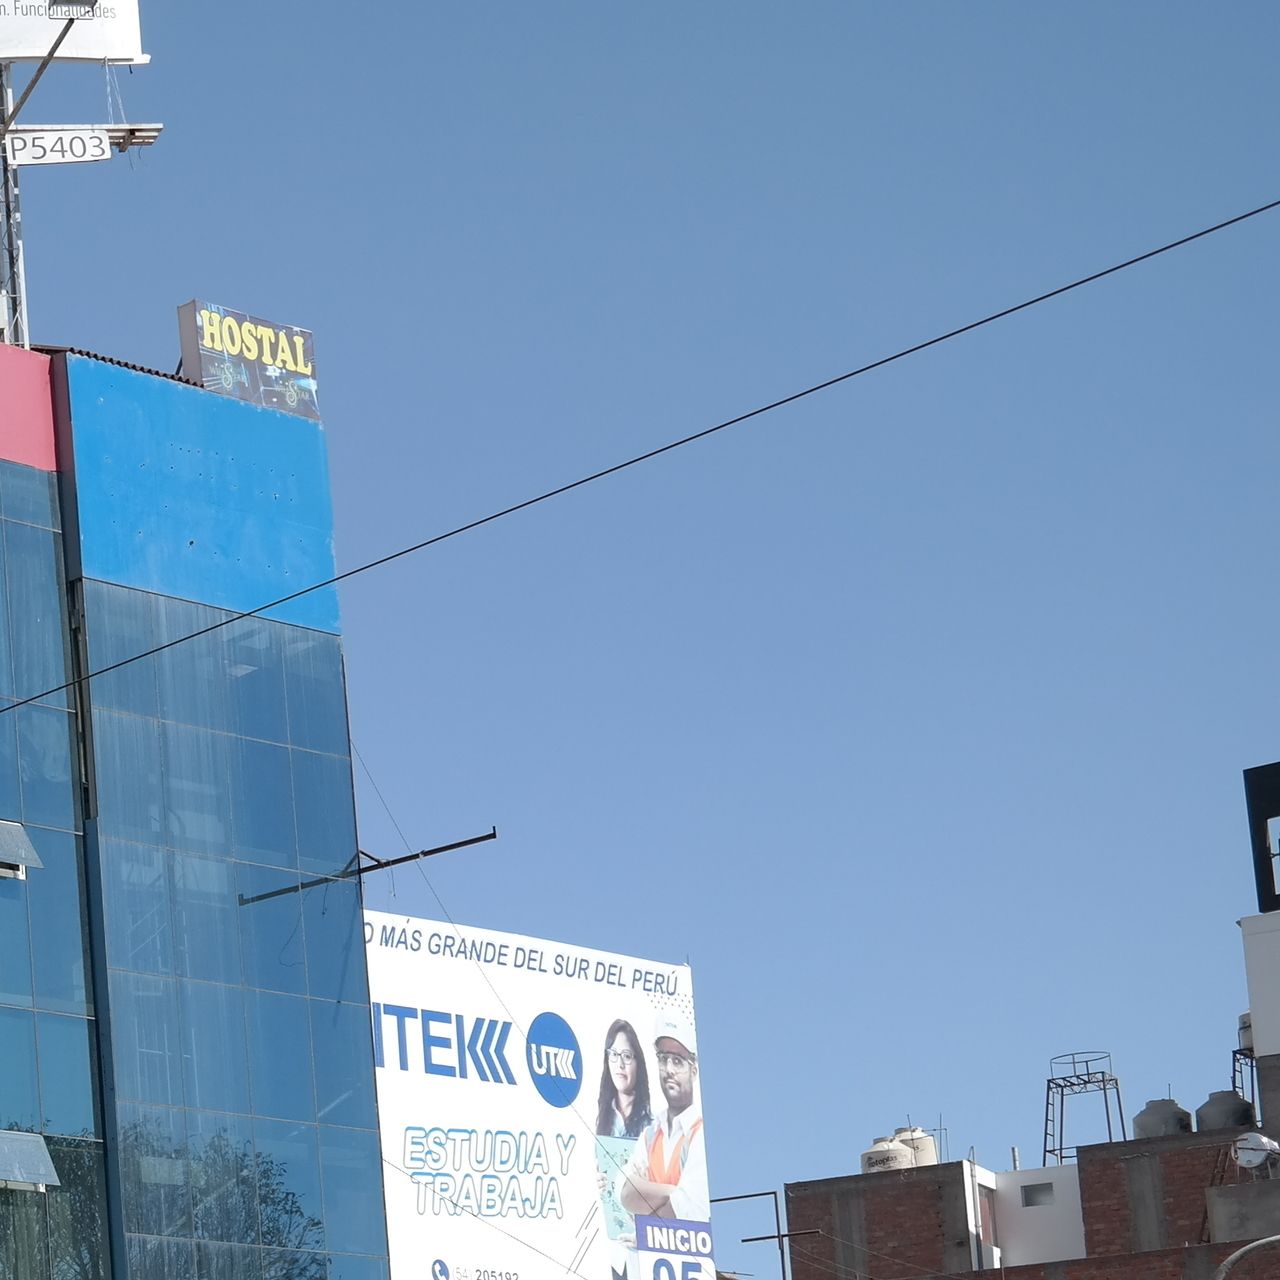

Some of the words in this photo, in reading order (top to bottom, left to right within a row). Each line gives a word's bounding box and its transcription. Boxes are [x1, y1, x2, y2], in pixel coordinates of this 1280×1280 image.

[10, 130, 107, 161] P5403
[200, 308, 313, 376] HOSTAL
[426, 932, 510, 968] GRANDE
[512, 945, 549, 974] DEL
[552, 953, 591, 982] SUR
[593, 962, 628, 989] DEL
[402, 1125, 550, 1176] ESTUDIA
[554, 1132, 577, 1176] Y
[410, 1171, 565, 1220] TRABAJA
[645, 1224, 713, 1255] INICIO
